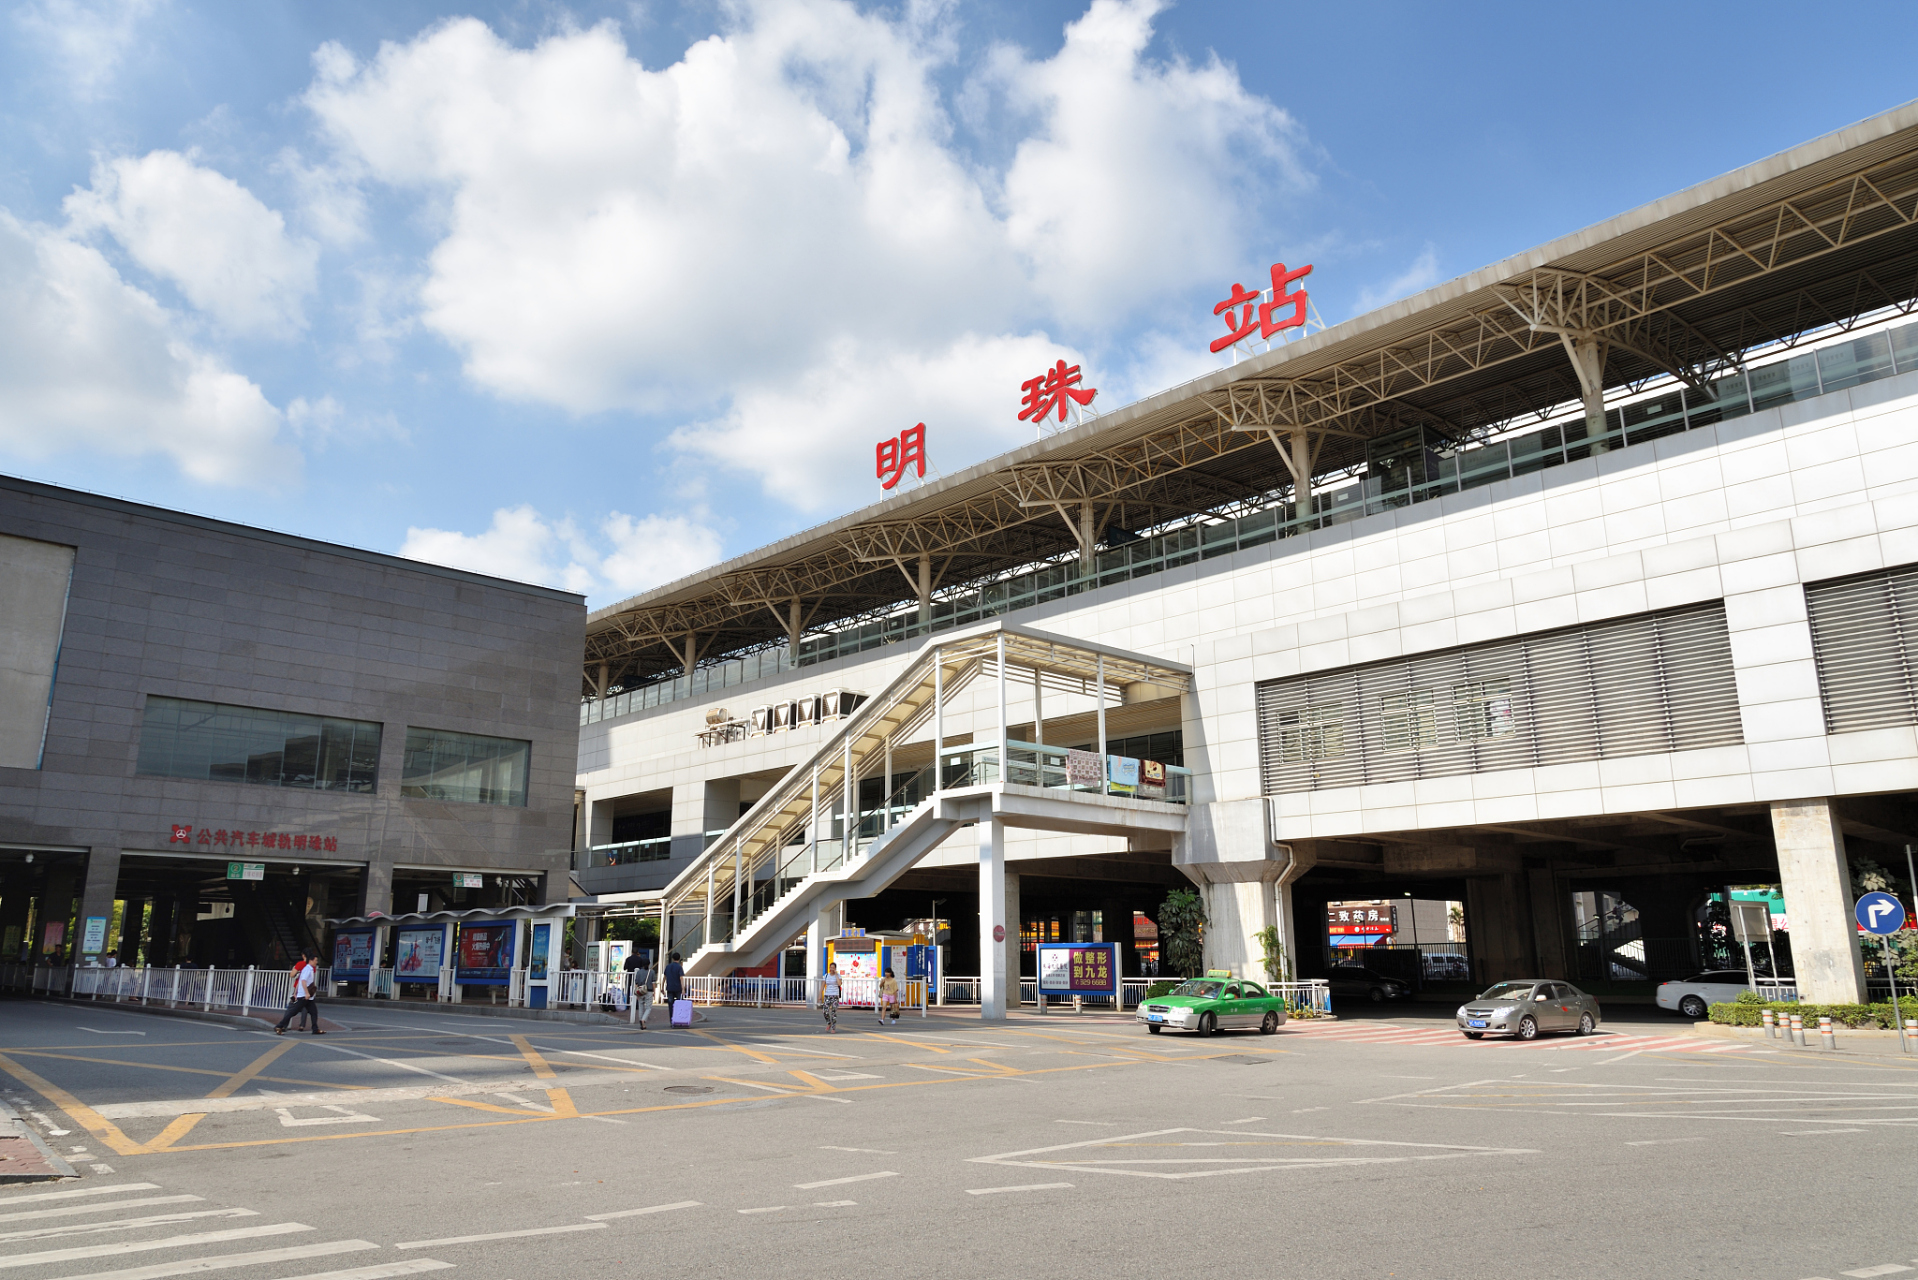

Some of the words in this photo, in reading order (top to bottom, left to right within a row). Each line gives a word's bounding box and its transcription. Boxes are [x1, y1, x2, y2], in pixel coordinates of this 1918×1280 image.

[197, 828, 338, 853] 公共汽车城轨明珠站
[1073, 951, 1107, 964] 做整形
[1073, 965, 1108, 979] 到九龙
